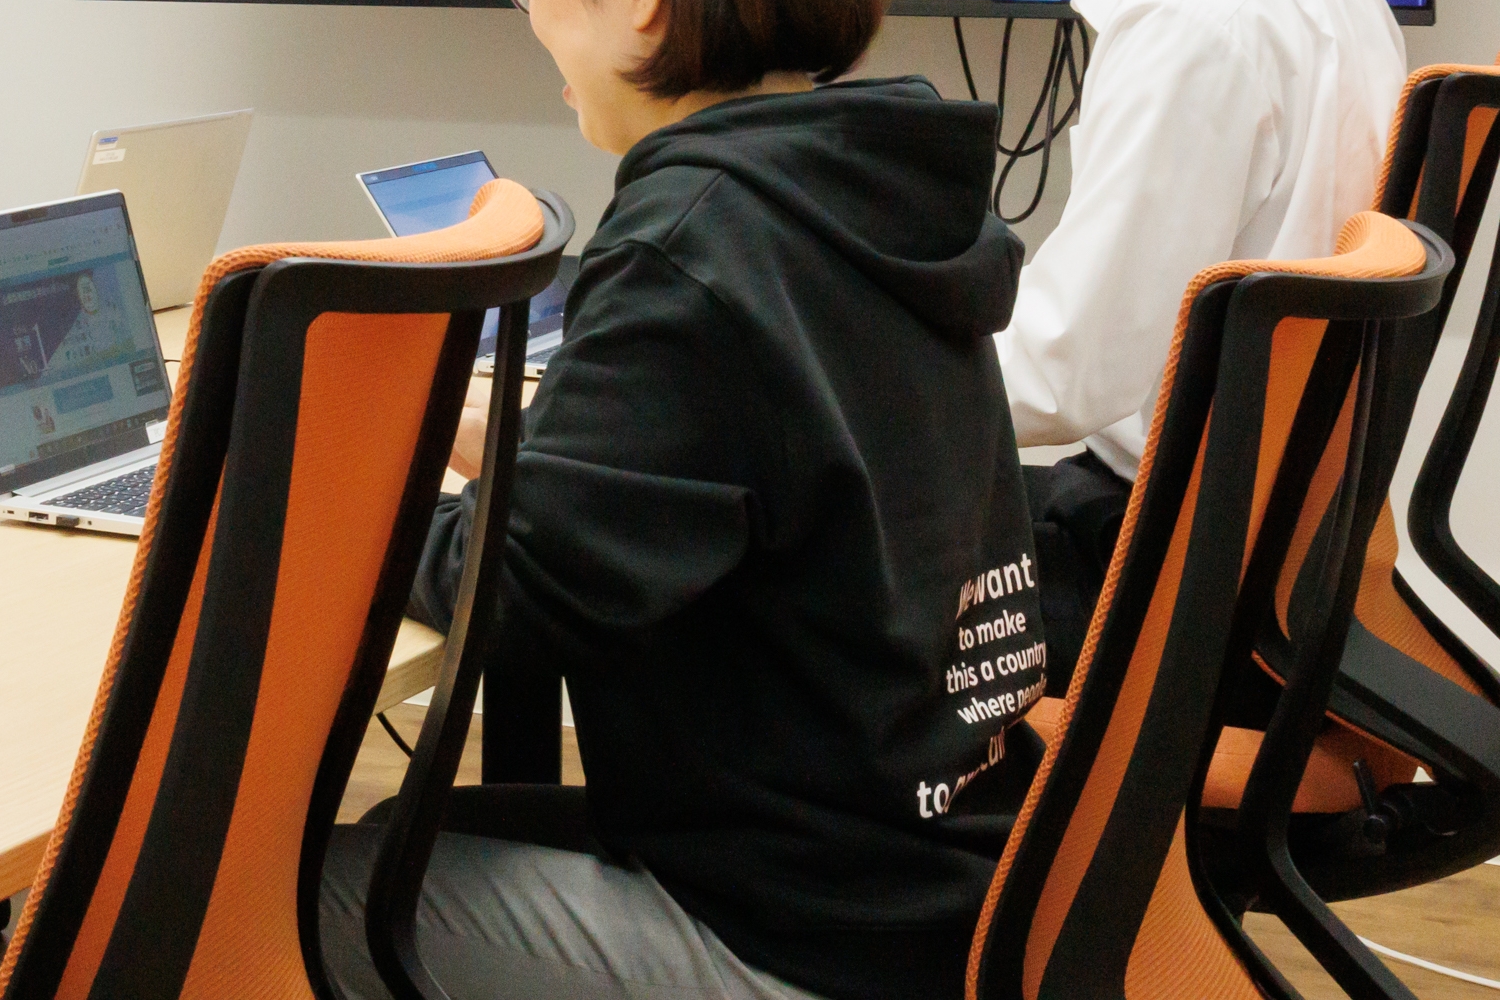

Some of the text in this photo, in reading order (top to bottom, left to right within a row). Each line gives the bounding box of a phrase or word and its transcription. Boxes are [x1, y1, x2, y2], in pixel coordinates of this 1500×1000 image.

[958, 609, 1027, 651] to make
[946, 640, 1047, 694] this a country
[957, 692, 1016, 725] where
